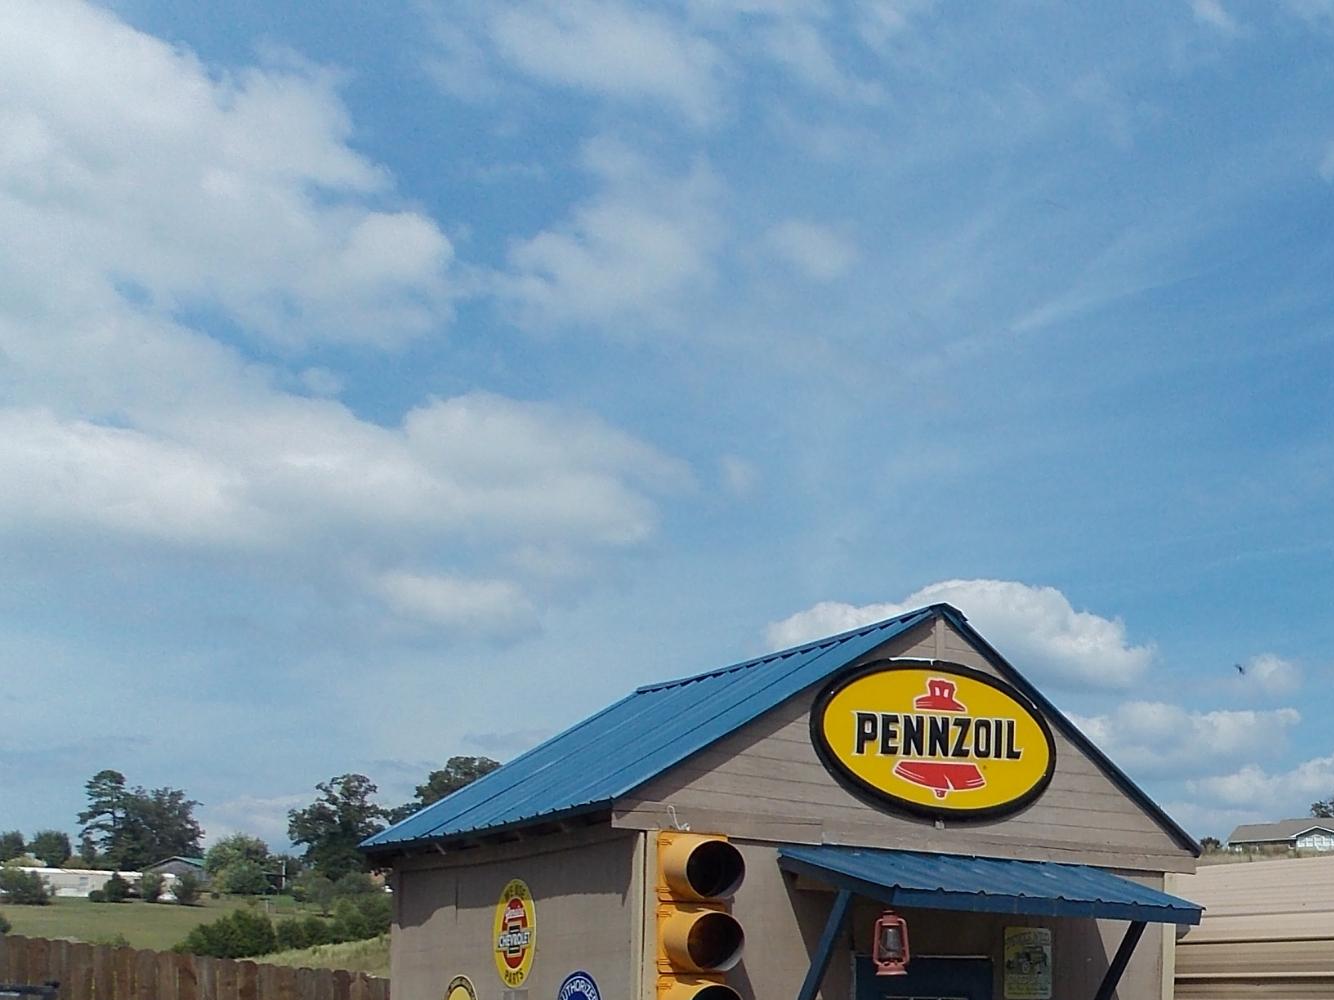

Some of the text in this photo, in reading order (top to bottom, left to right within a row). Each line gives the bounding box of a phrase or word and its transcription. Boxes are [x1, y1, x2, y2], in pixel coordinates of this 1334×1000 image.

[856, 712, 1022, 759] PENNZOIL
[499, 932, 530, 948] CHEVROLET
[504, 968, 524, 985] PARTS
